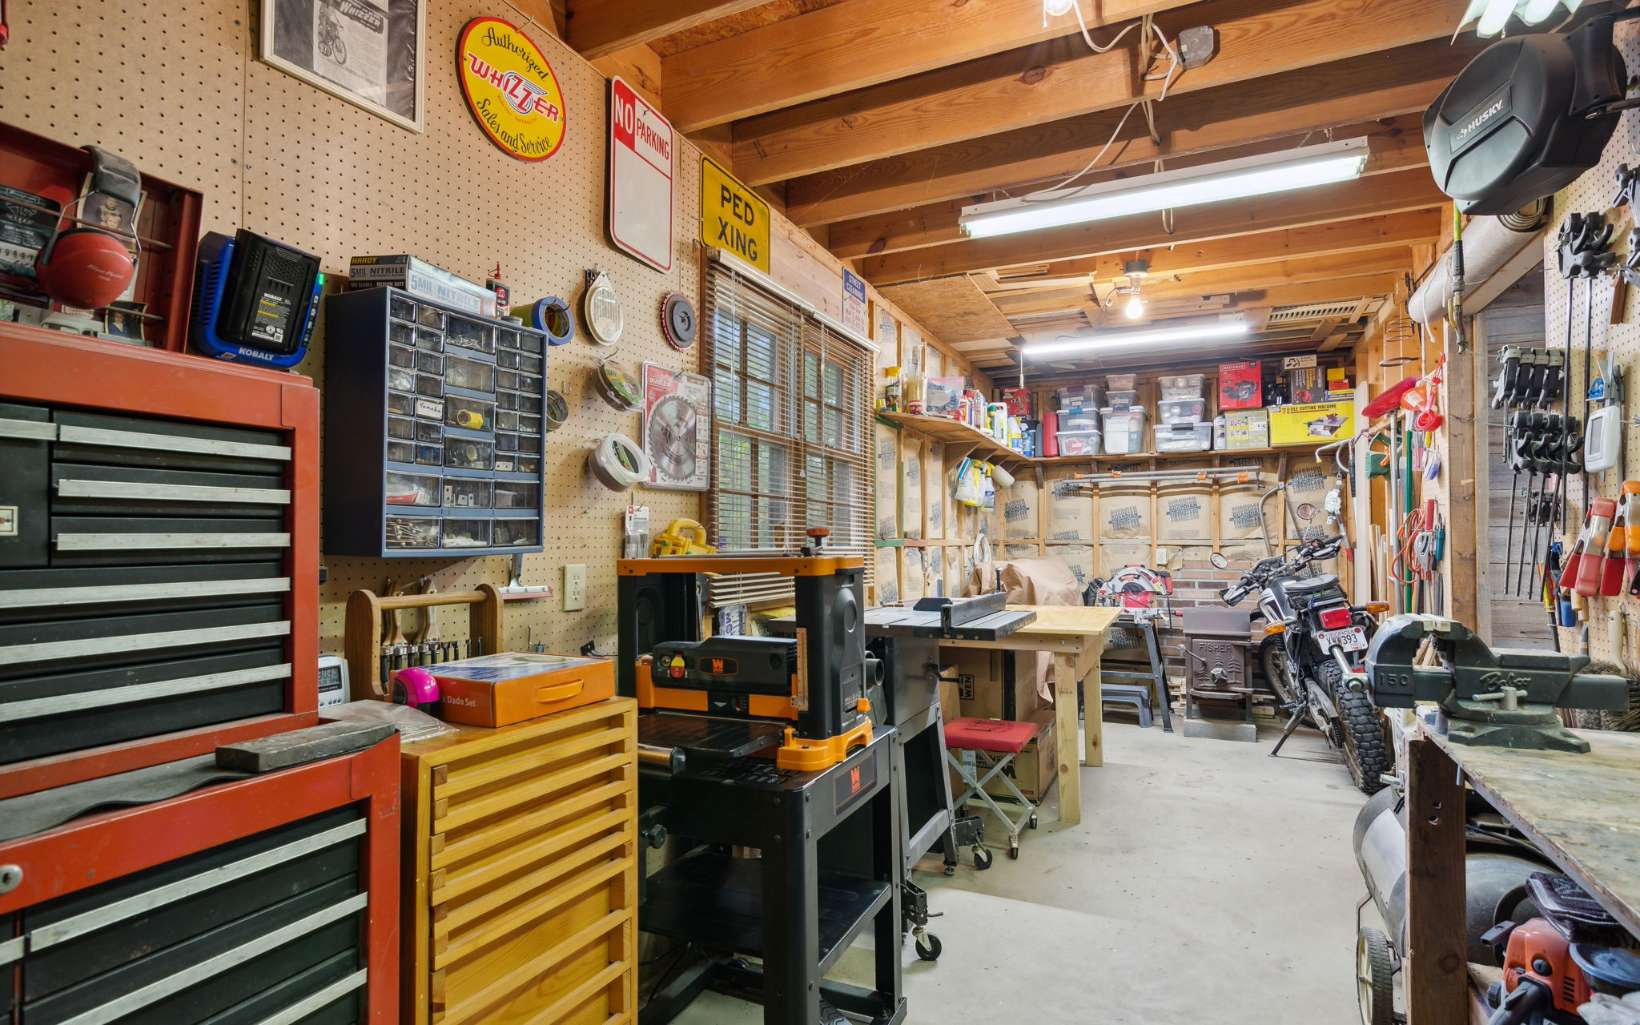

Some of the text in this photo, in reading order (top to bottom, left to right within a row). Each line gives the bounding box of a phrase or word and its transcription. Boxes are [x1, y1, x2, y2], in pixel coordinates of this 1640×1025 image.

[481, 27, 549, 80] Authorized
[468, 52, 559, 122] WHIZZER
[477, 98, 552, 154] Sales and Service
[615, 94, 634, 135] NO
[1467, 99, 1503, 132] HUSKY
[636, 118, 670, 161] PARKING
[720, 184, 755, 226] PED
[717, 216, 758, 262] XING
[238, 346, 274, 361] KOBALT
[1199, 642, 1232, 653] FISHER
[1380, 673, 1409, 686] 150
[448, 696, 476, 707] Dado Set
